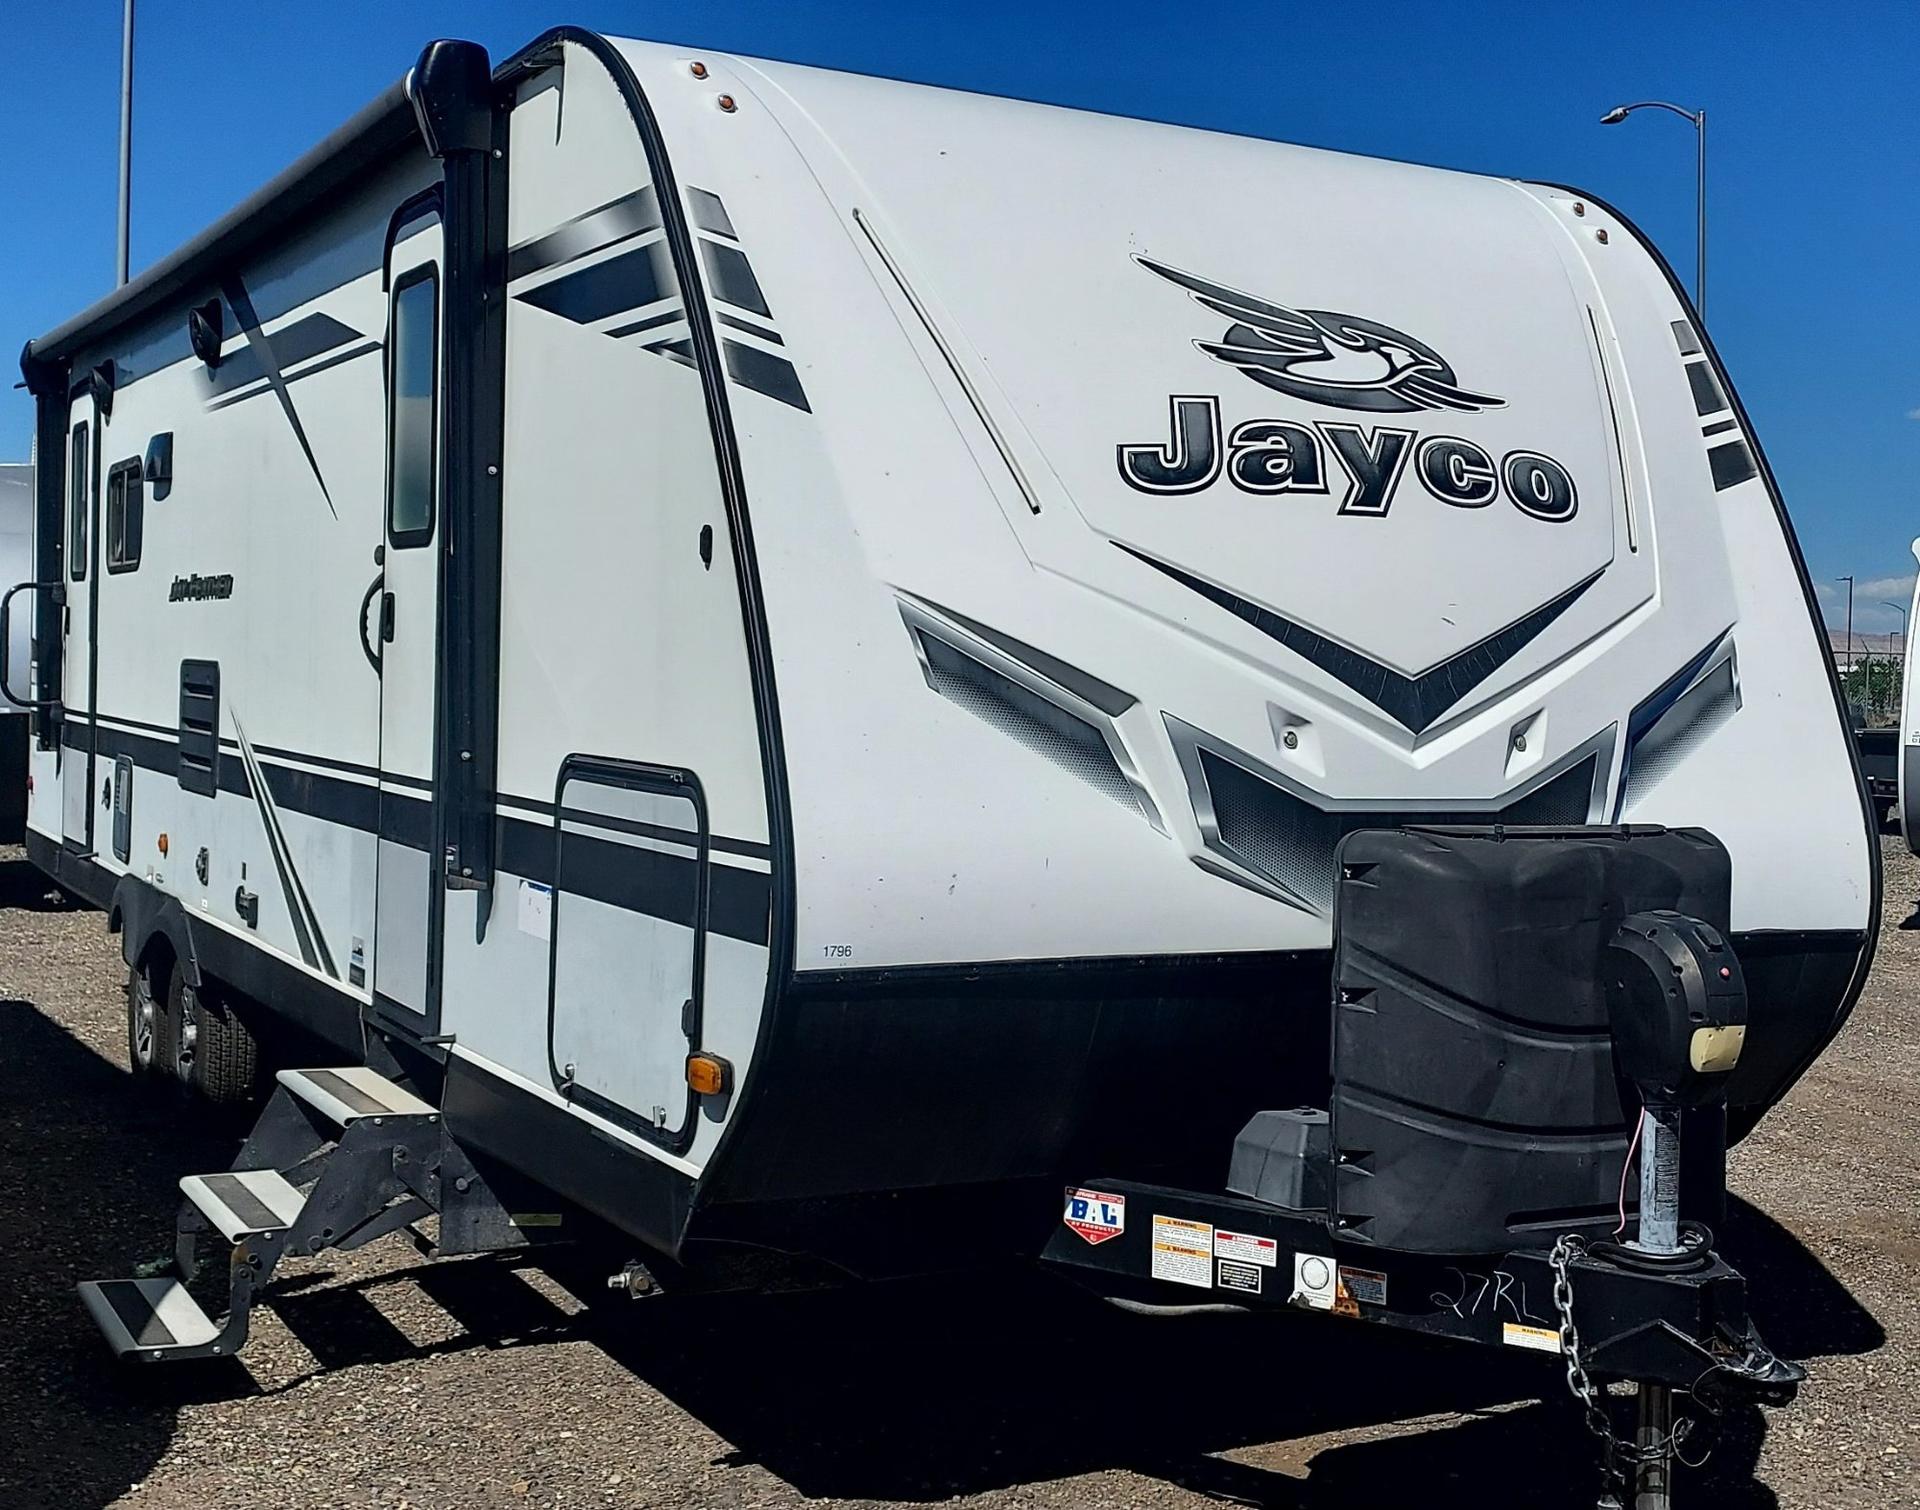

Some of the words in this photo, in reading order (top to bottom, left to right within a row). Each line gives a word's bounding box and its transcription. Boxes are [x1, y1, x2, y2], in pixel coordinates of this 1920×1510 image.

[1117, 394, 1579, 523] Jayco
[823, 945, 853, 958] 1796
[1071, 1198, 1118, 1226] BAL
[1429, 1266, 1550, 1324] 27RL
